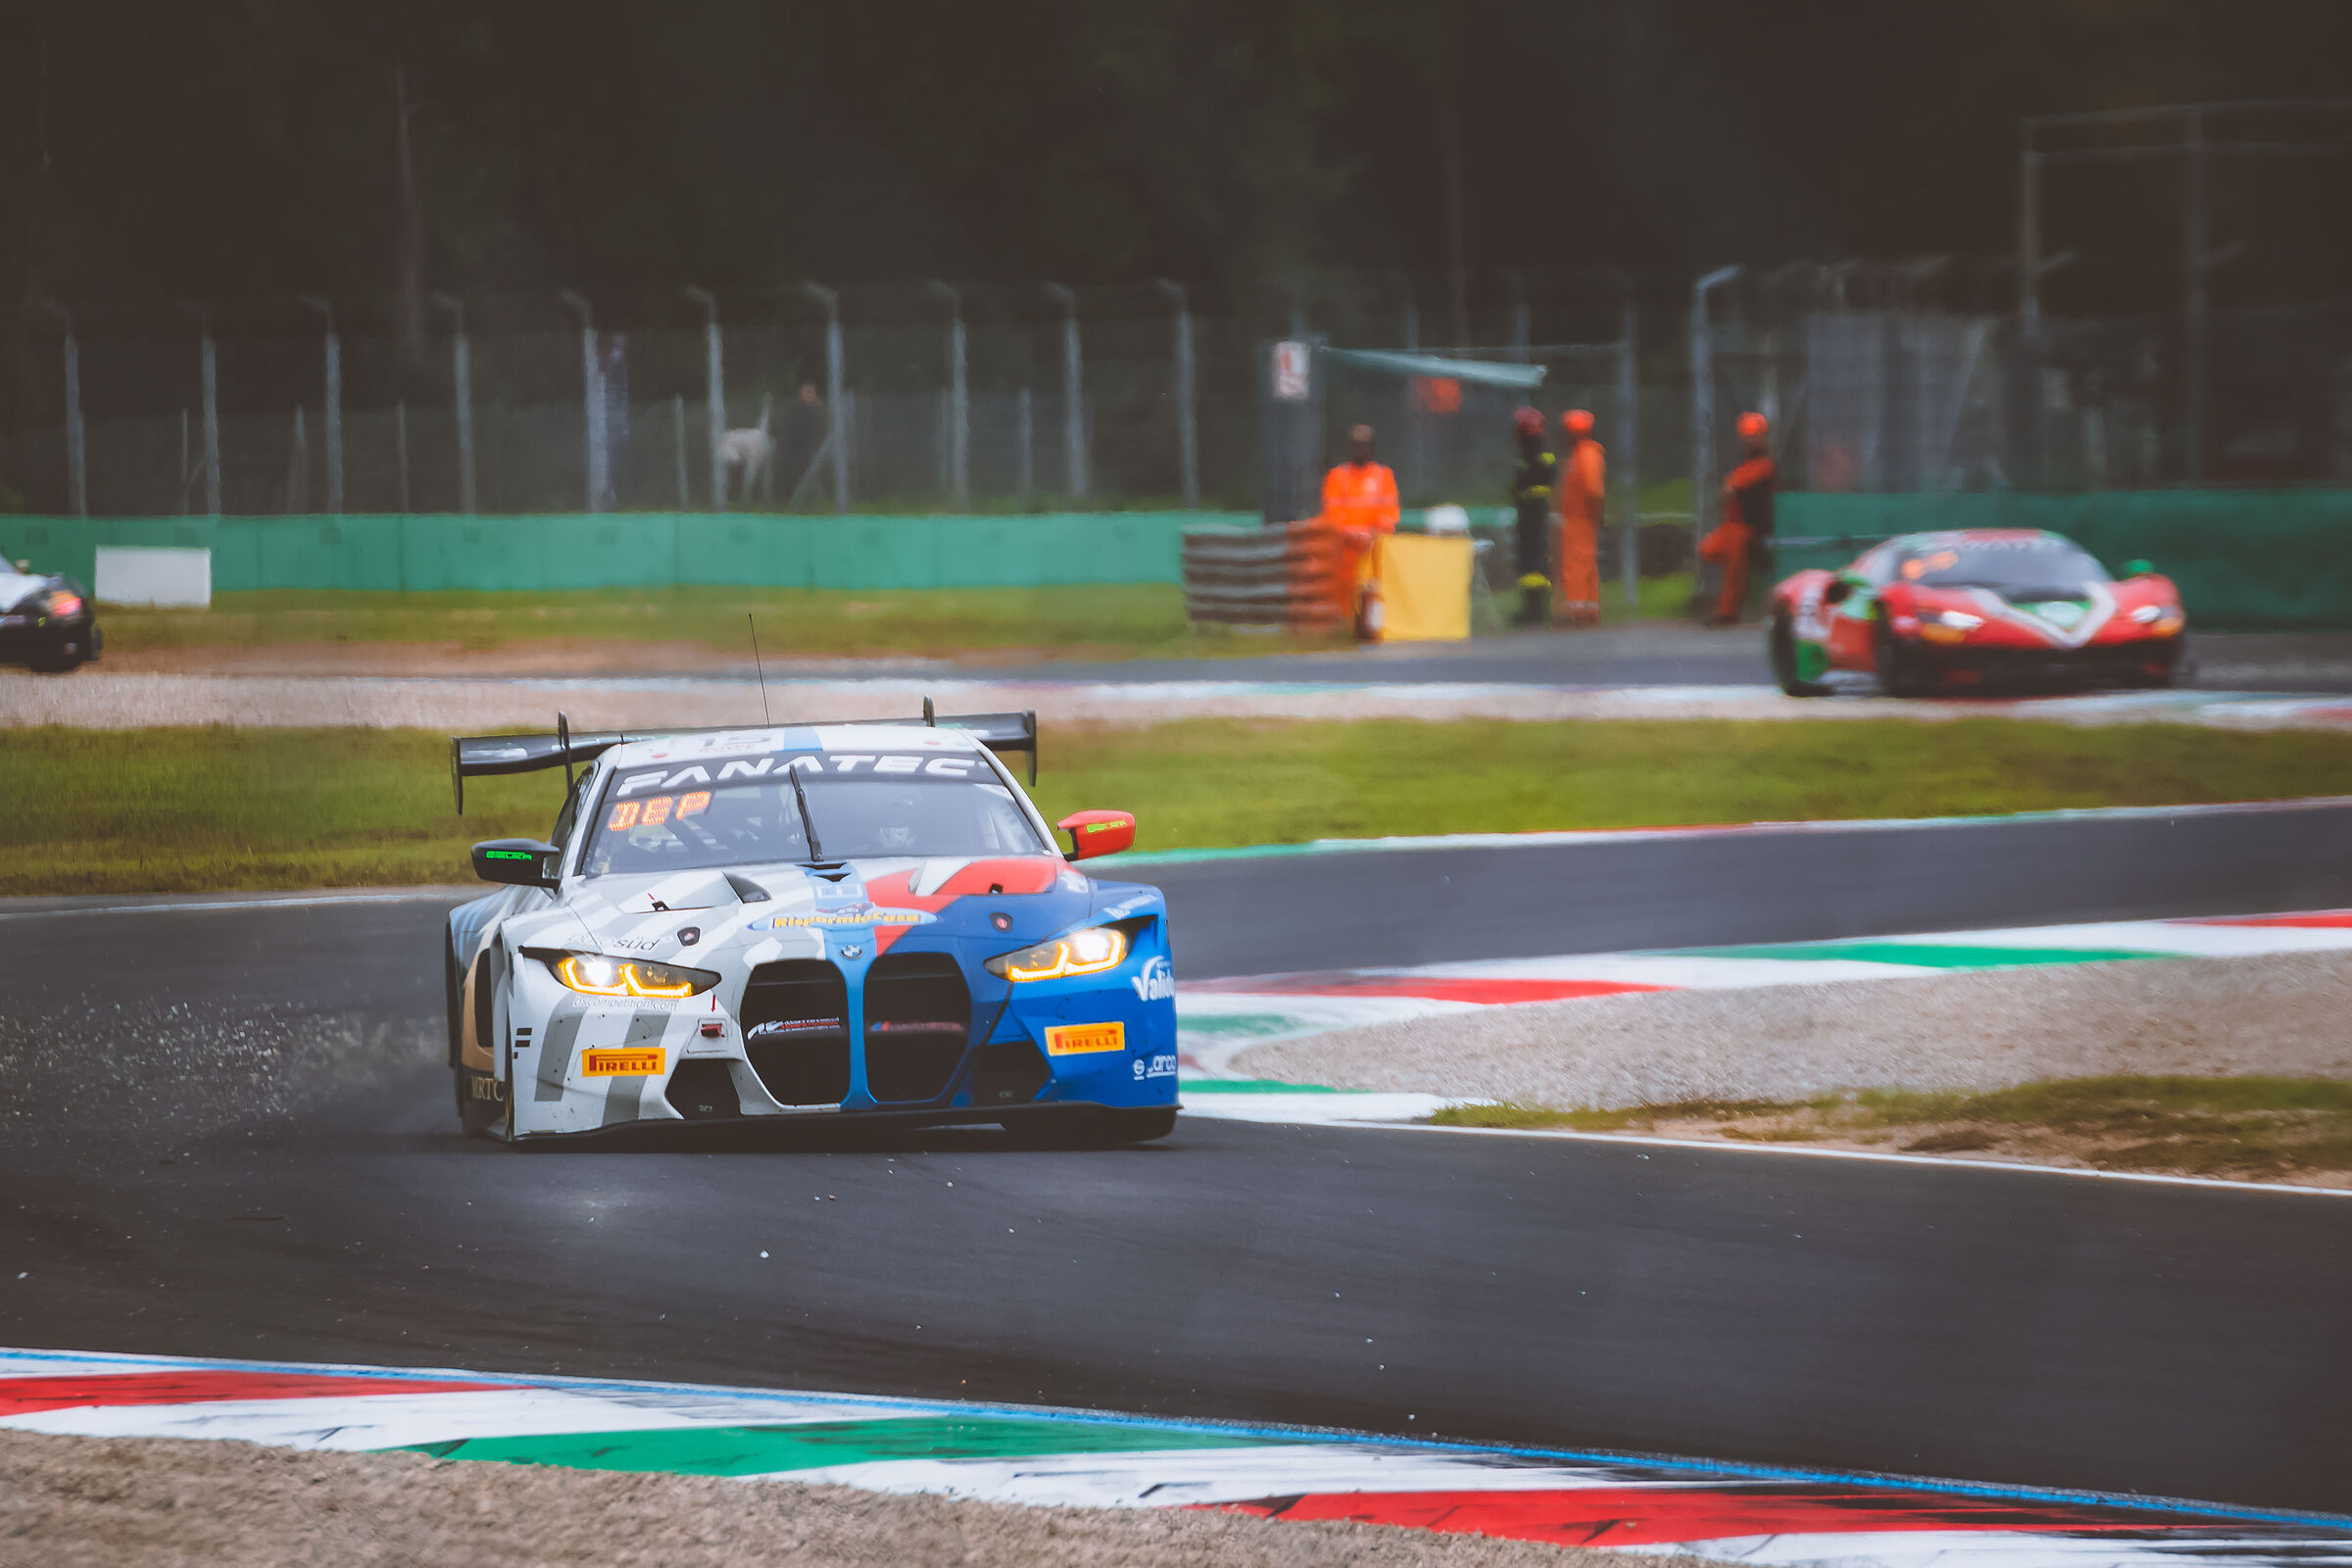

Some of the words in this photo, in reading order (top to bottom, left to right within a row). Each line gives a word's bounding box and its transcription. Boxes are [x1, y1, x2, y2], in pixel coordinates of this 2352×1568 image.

[616, 756, 976, 797] FANATEC
[1054, 1028, 1118, 1050] PIRELLI
[589, 1054, 659, 1072] PIRELLI
